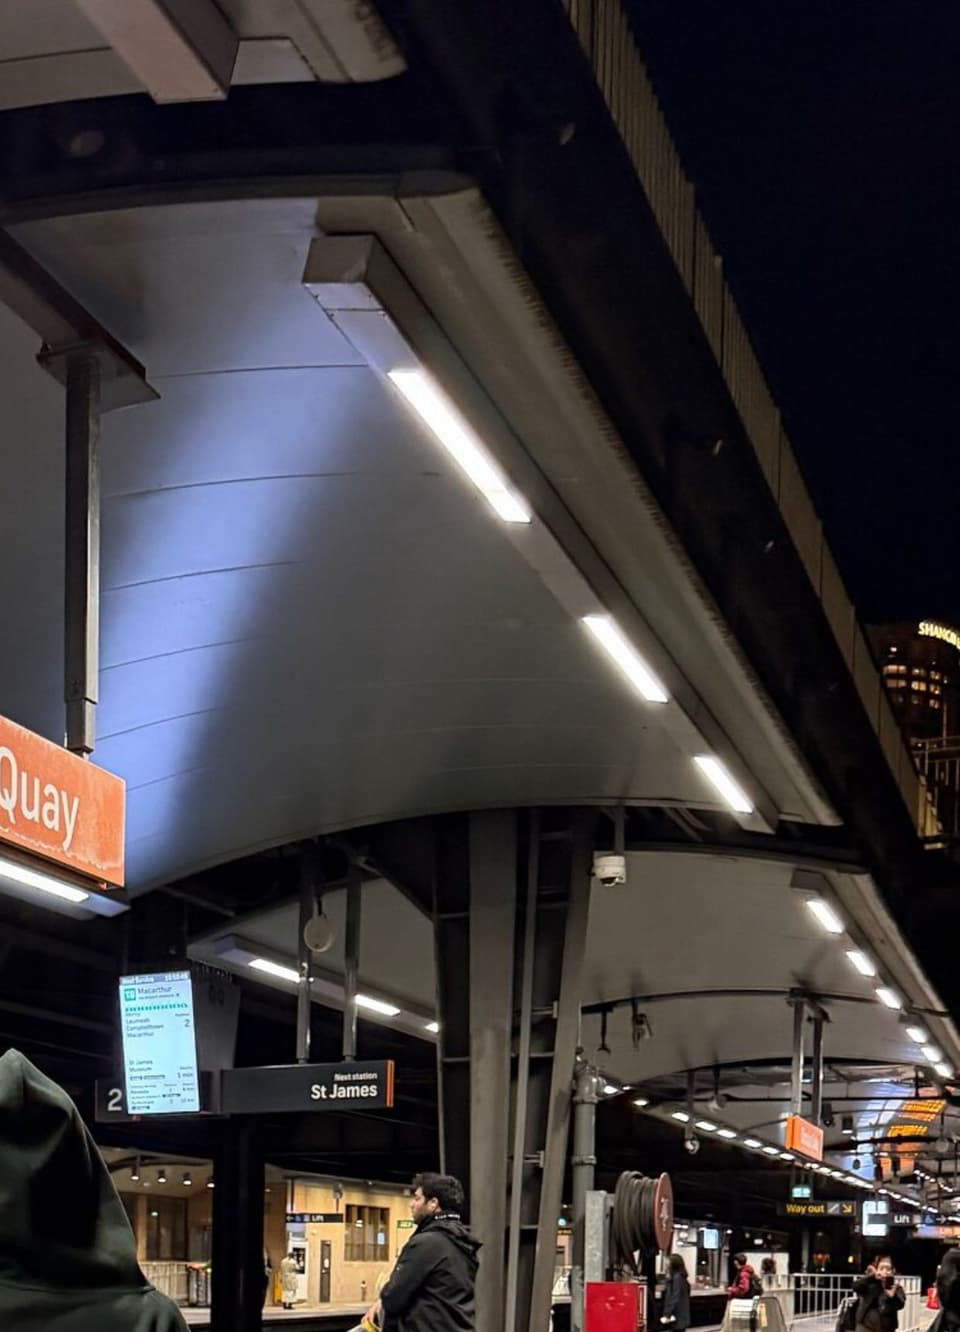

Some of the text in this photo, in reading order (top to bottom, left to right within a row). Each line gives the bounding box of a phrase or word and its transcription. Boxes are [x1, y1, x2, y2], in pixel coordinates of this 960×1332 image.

[333, 1072, 378, 1081] Next station
[311, 1083, 378, 1100] St James
[108, 1088, 123, 1112] 2
[786, 1203, 825, 1215] Way out
[894, 1214, 910, 1224] Lift
